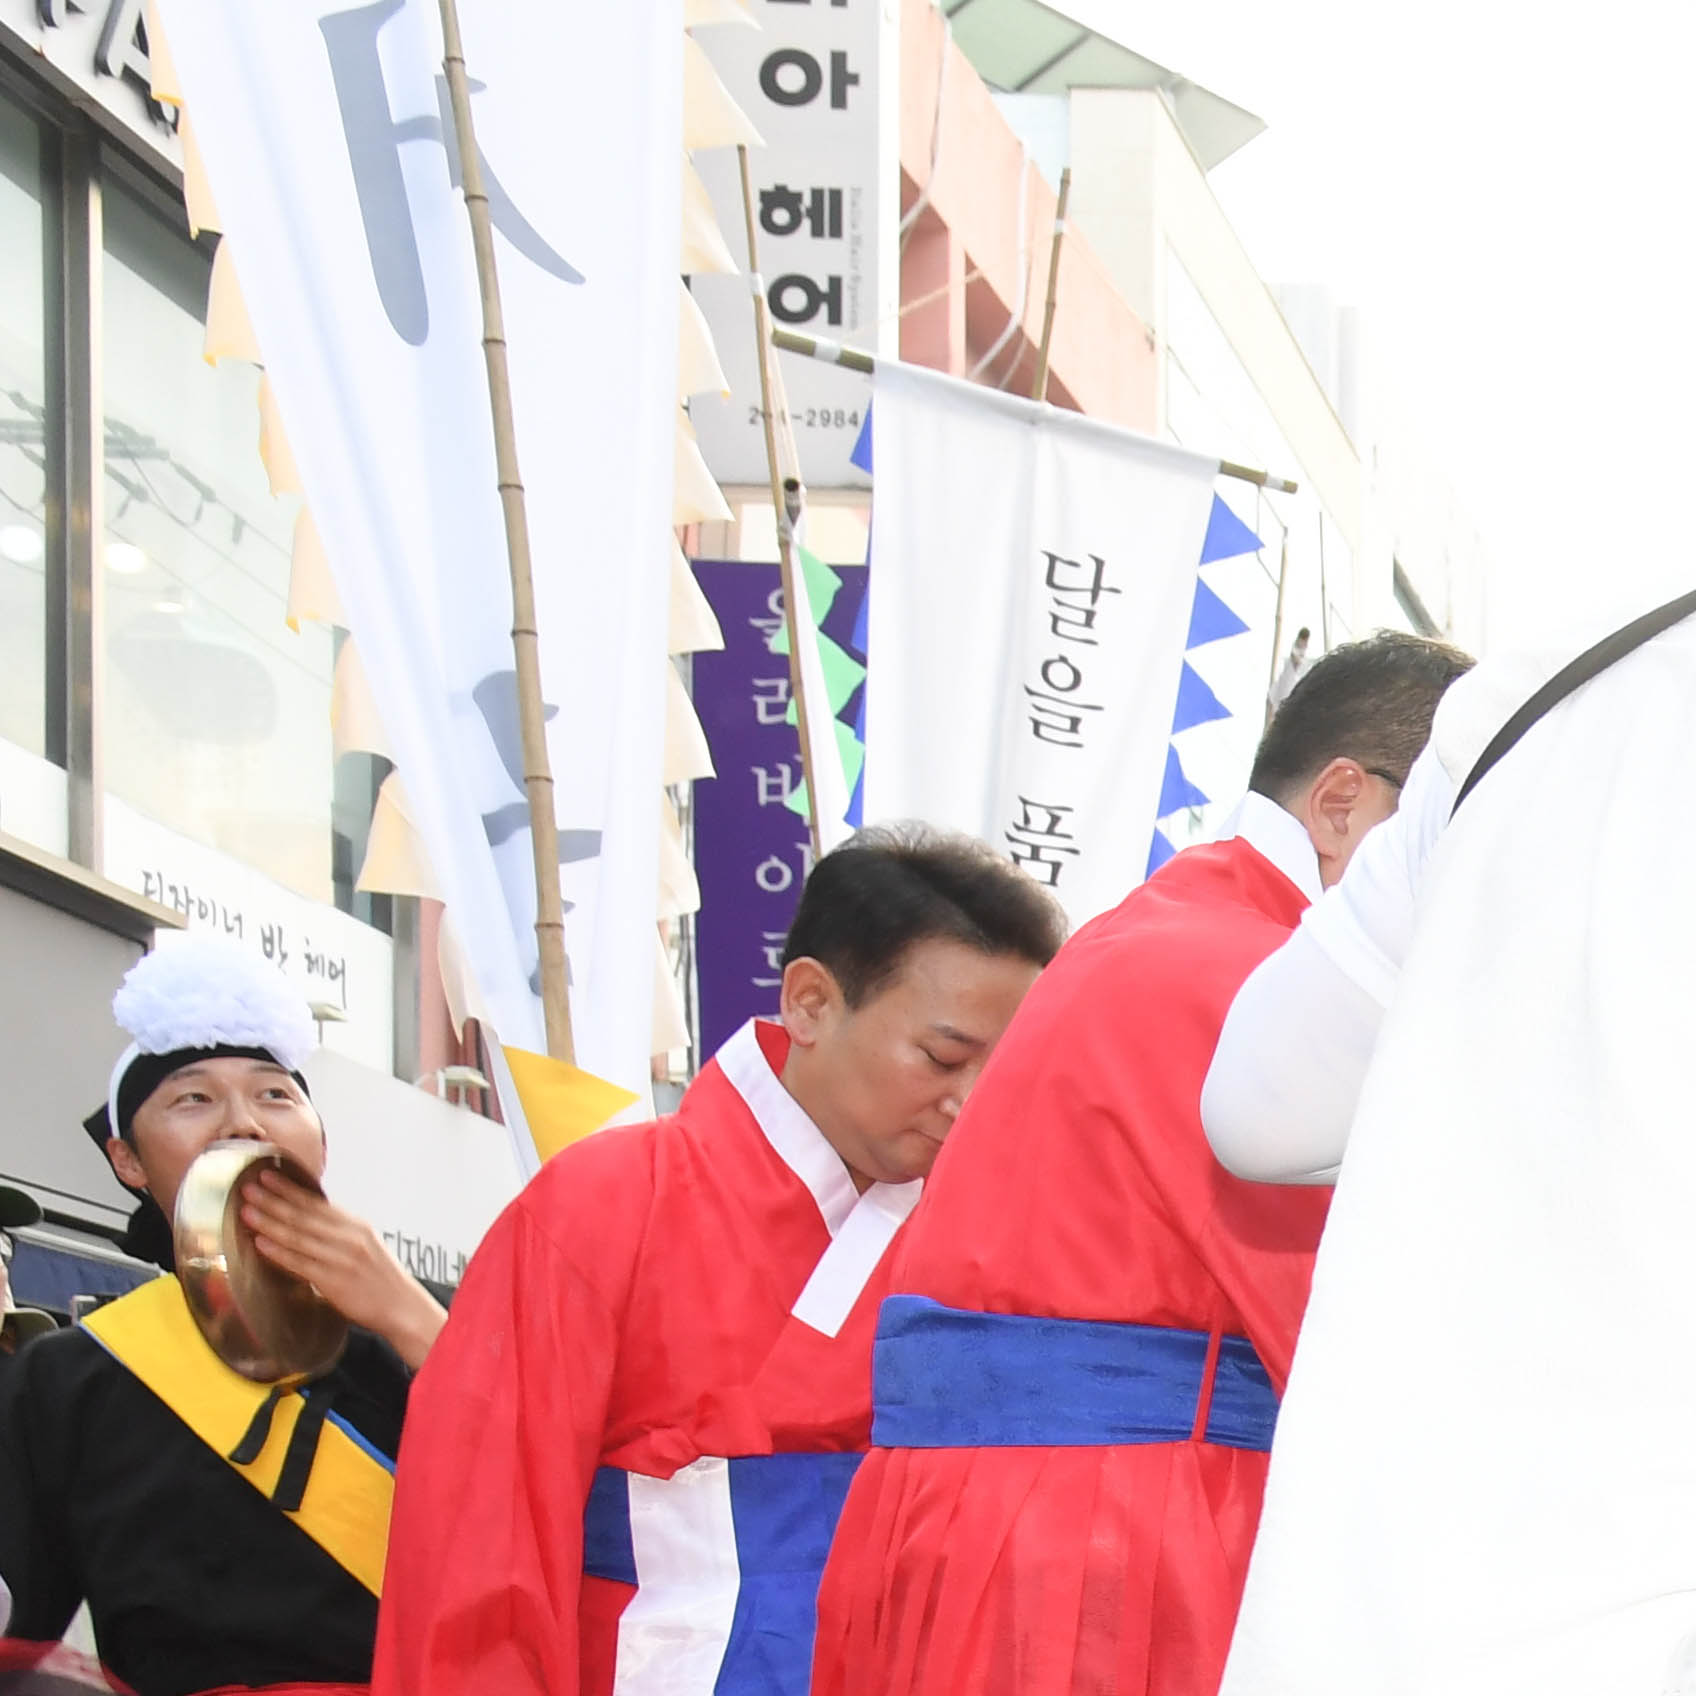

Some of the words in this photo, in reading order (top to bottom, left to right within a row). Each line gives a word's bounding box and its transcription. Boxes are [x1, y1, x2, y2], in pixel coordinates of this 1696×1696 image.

[758, 0, 861, 110] 아
[758, 184, 844, 327] 헤어
[748, 405, 859, 429] 2-2984
[1024, 550, 1122, 749] 달을
[142, 869, 243, 939] 디자이너
[304, 936, 347, 1010] 헤어
